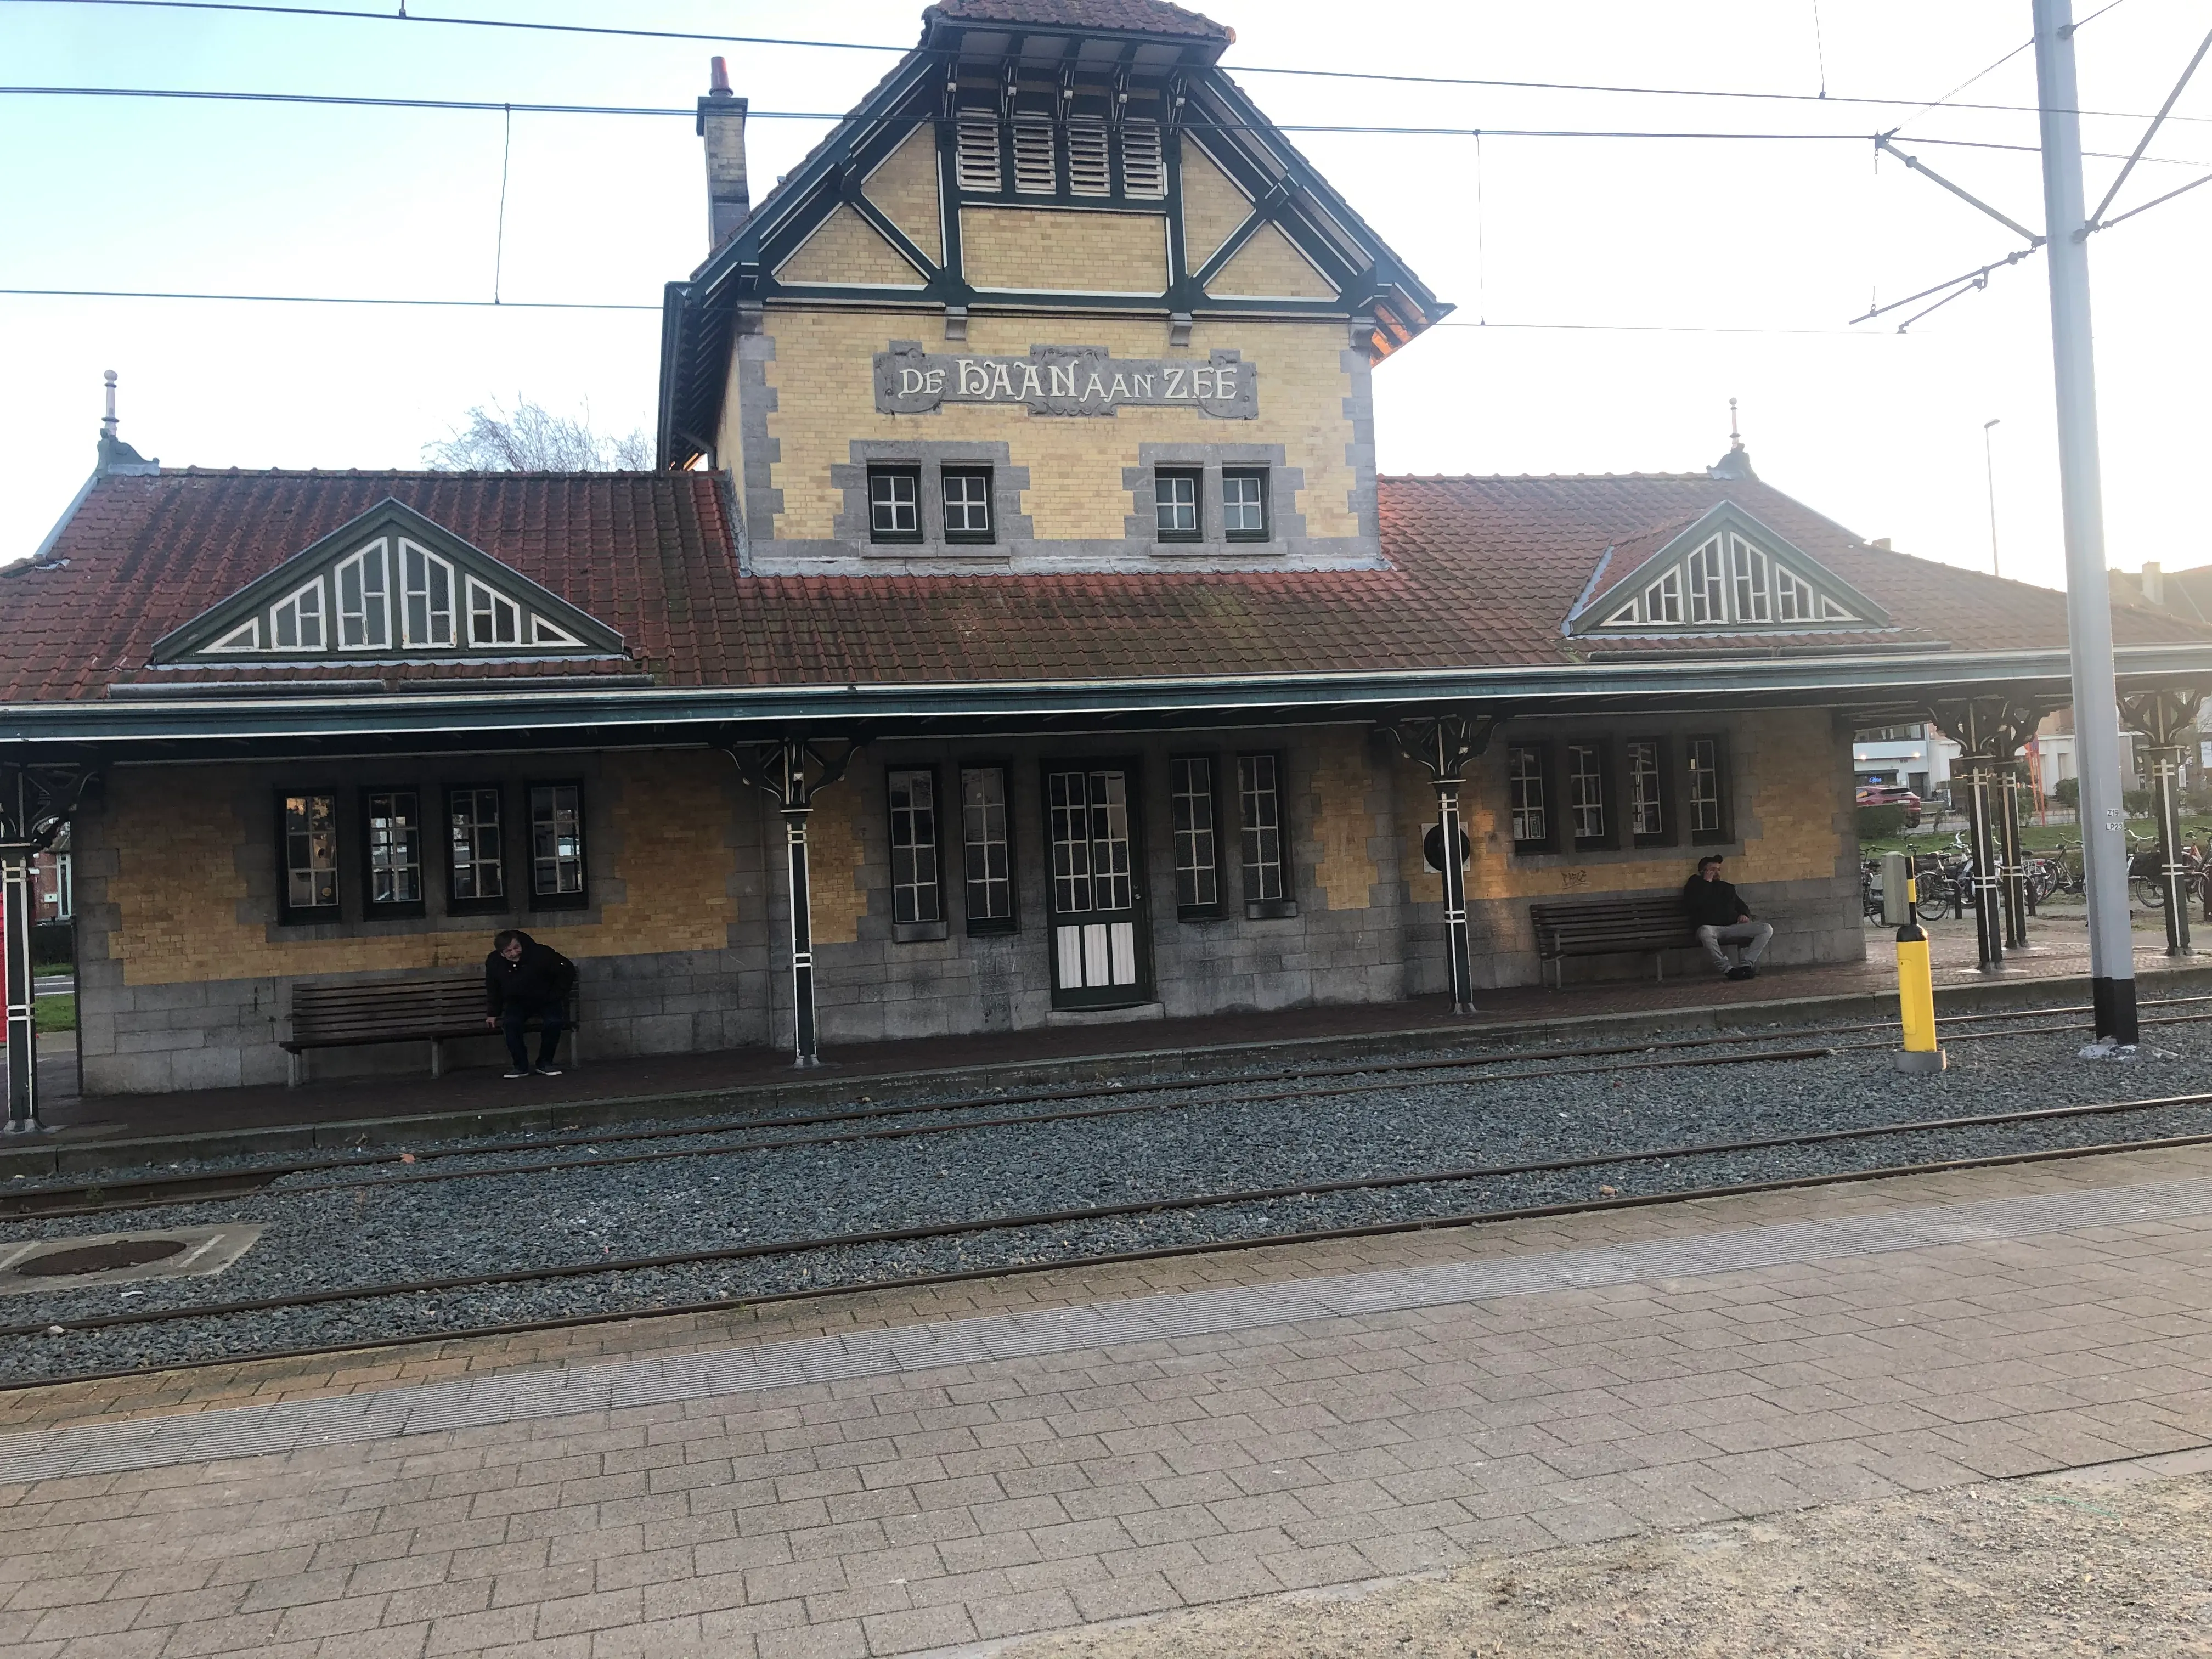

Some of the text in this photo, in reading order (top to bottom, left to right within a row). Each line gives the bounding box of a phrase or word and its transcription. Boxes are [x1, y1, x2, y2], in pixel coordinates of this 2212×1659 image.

[898, 359, 1238, 403] DE HAAN AAN ZEE
